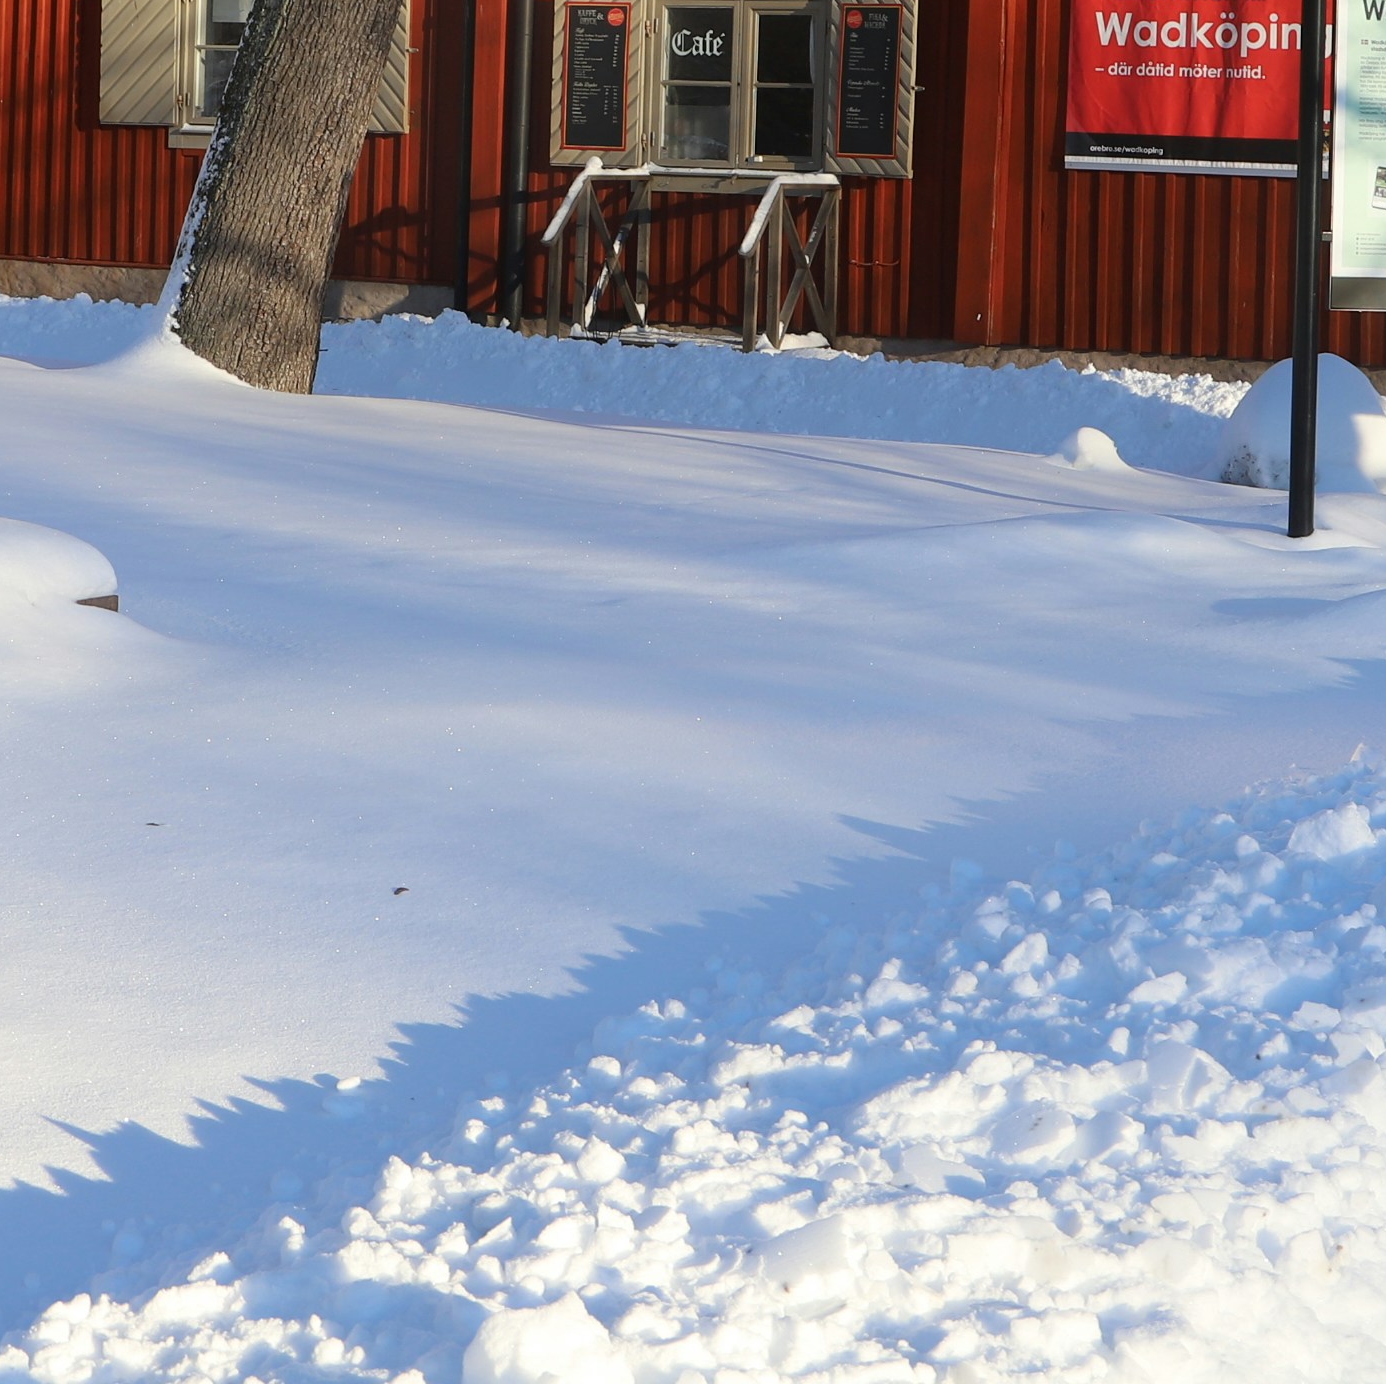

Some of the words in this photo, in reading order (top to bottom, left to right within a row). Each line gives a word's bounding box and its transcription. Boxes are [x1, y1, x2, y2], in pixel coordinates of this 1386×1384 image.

[671, 29, 725, 57] Café
[1095, 12, 1332, 58] Wadköpin
[1108, 63, 1133, 77] där
[1136, 61, 1174, 78] dåtid
[1179, 64, 1223, 79] möter
[1226, 65, 1266, 80] nutid.
[1089, 144, 1165, 156] orebro.se/wadkoping
